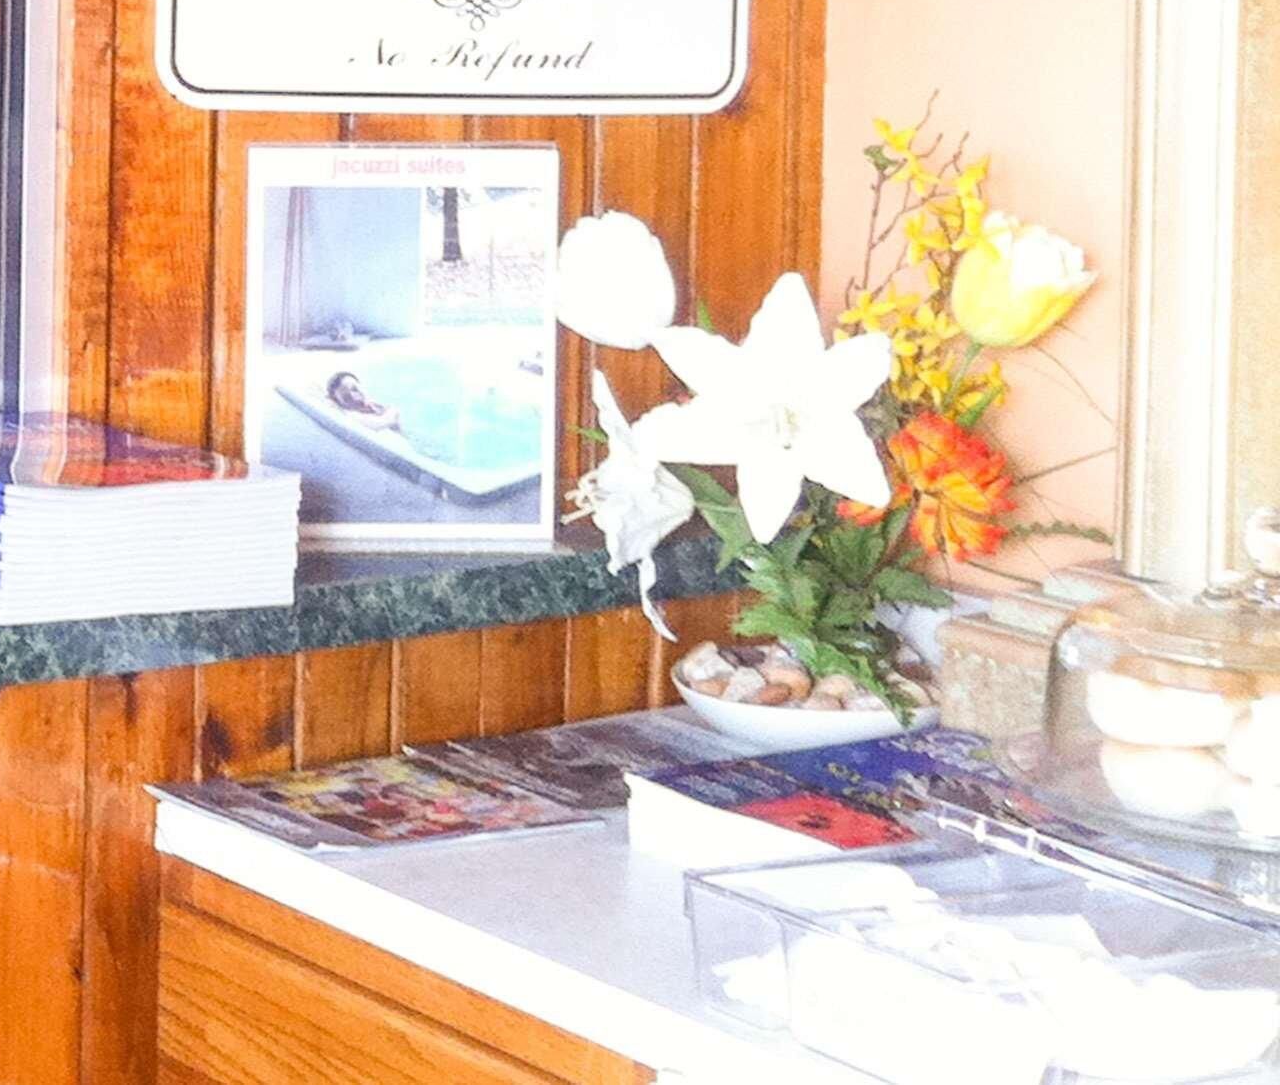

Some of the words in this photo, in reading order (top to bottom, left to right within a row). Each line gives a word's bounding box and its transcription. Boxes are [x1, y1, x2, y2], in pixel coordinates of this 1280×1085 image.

[430, 38, 594, 83] Refund
[331, 155, 401, 179] jacuzzi
[407, 154, 467, 175] suites
